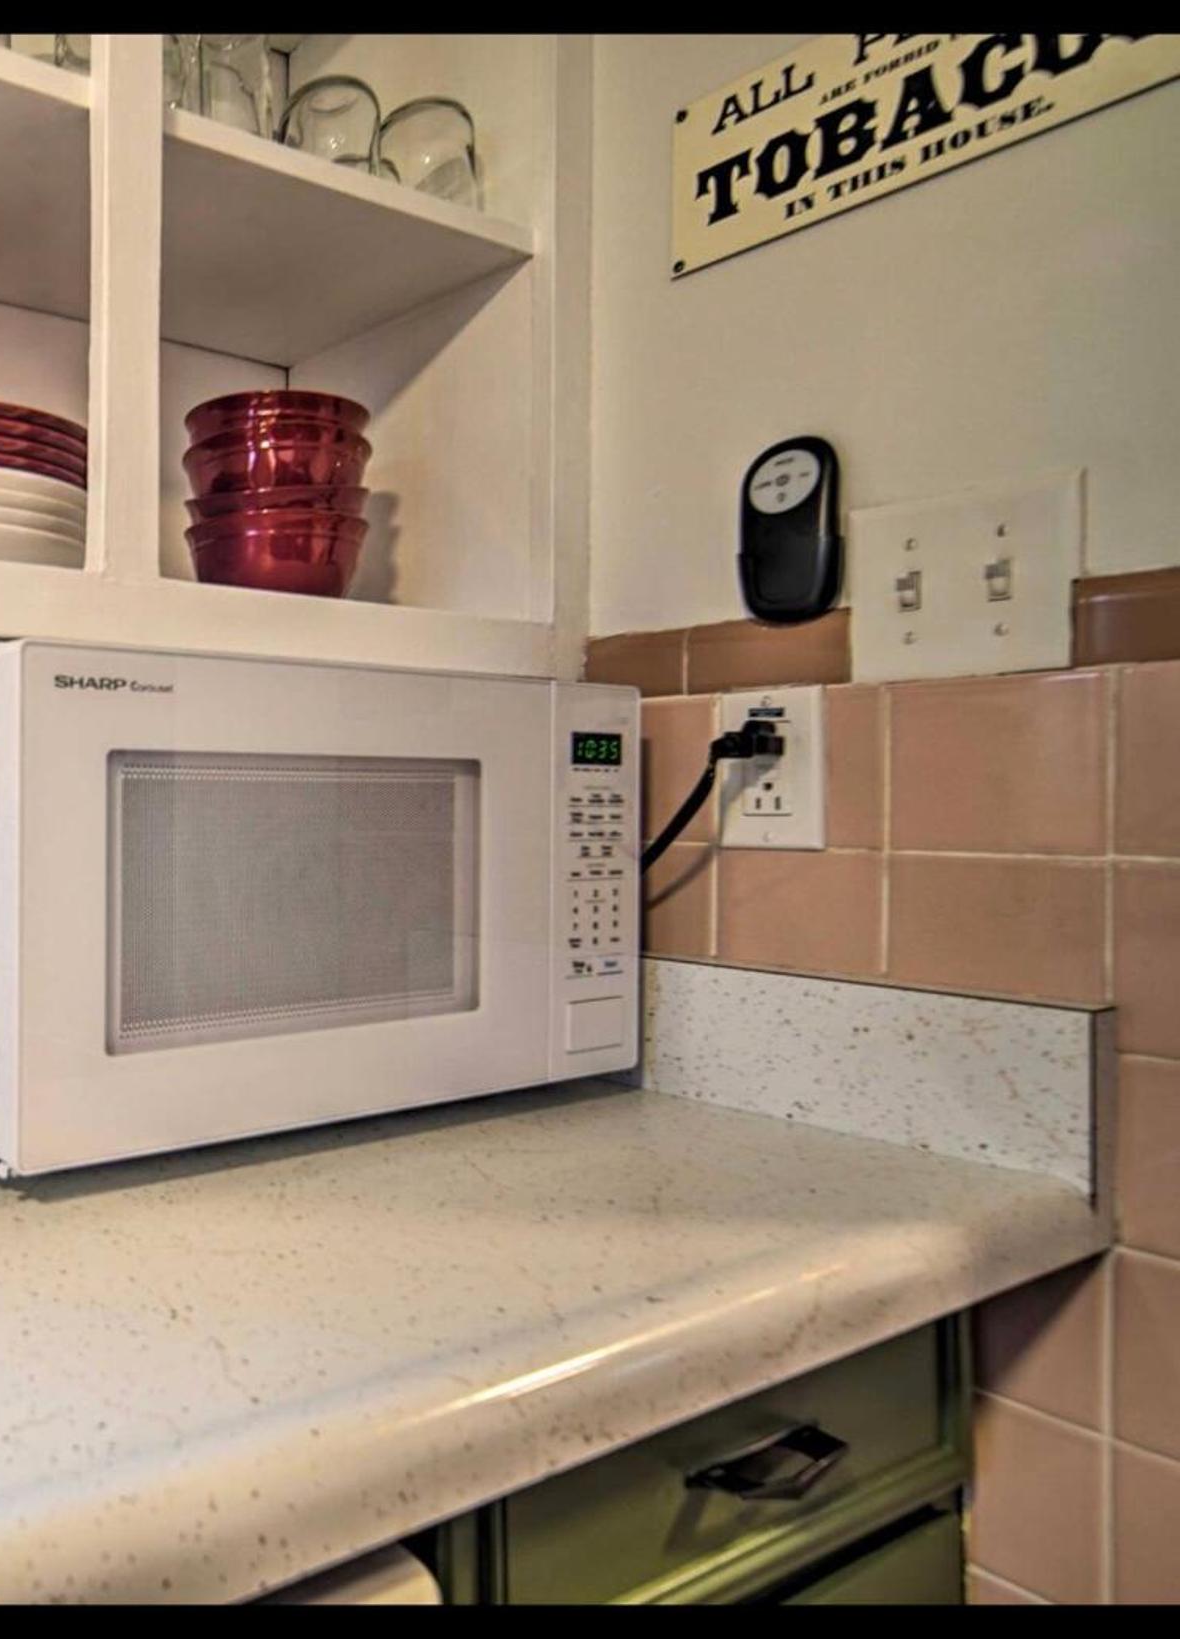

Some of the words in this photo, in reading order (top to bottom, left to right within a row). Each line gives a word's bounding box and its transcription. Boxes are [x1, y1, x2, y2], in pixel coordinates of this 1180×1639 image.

[710, 63, 815, 135] ALL
[783, 193, 815, 221] IN
[826, 154, 907, 202] THIS
[919, 96, 1057, 164] HOUSE.
[53, 673, 128, 691] SHARP
